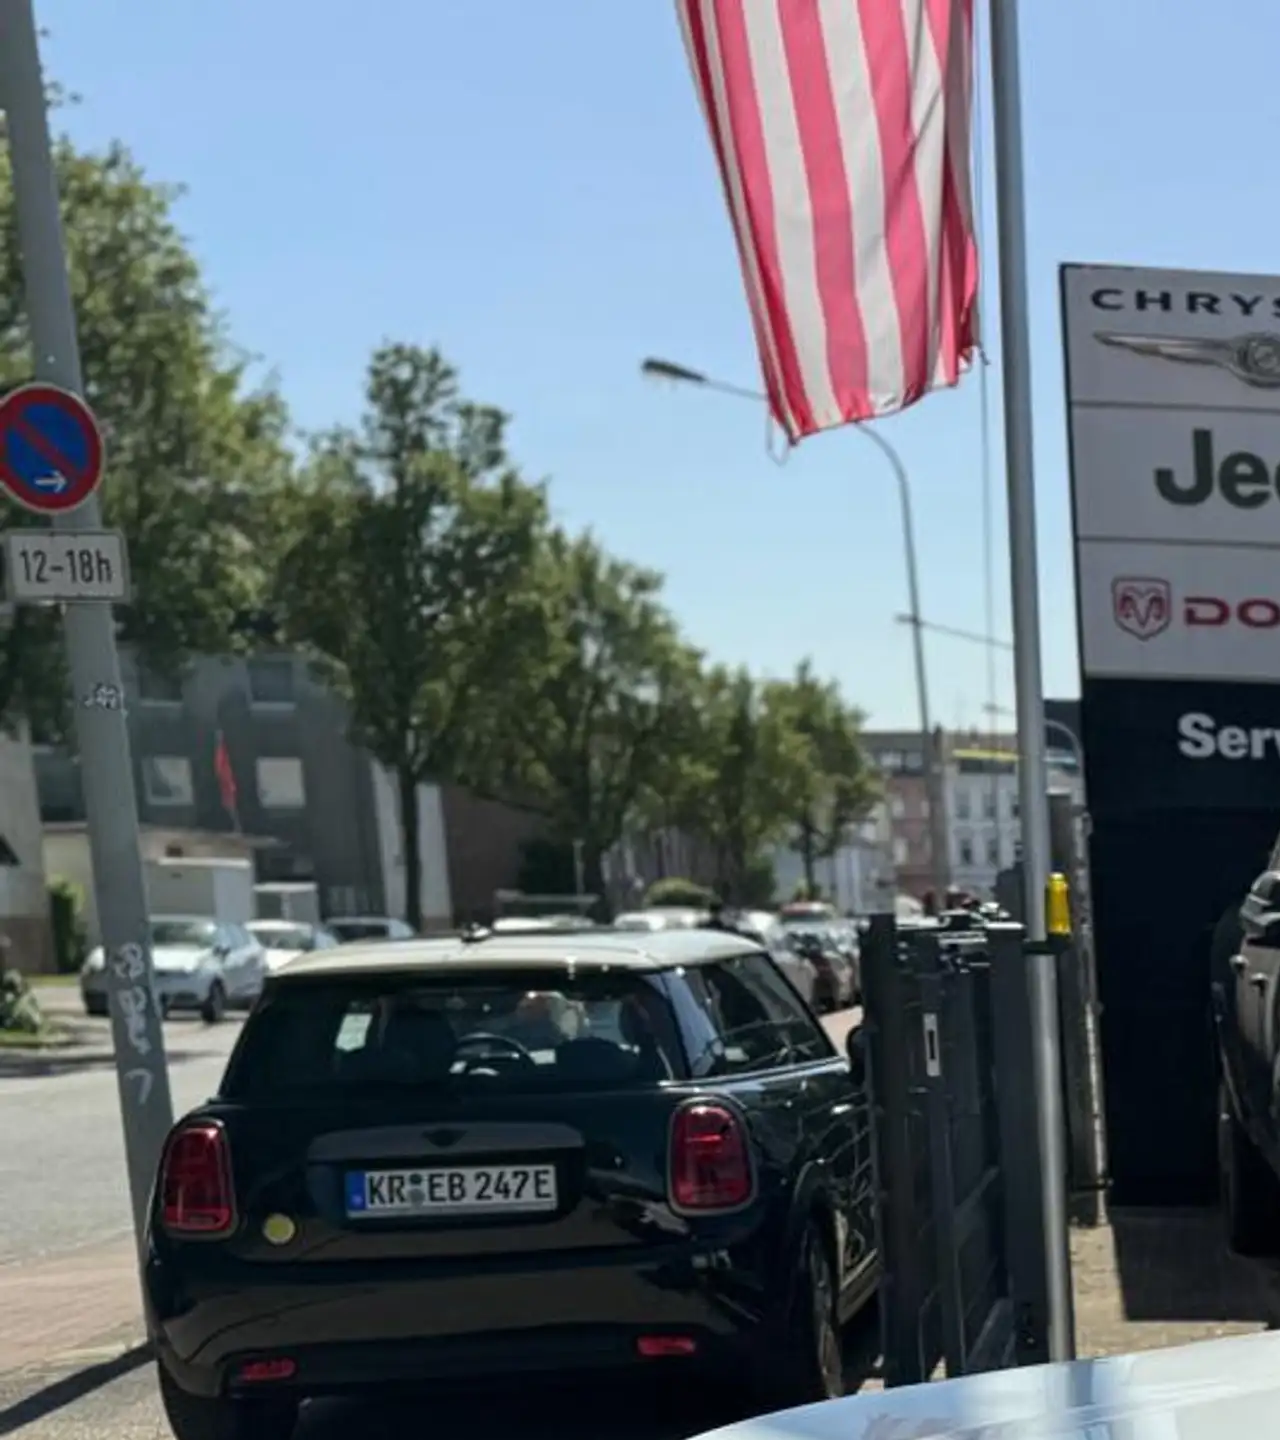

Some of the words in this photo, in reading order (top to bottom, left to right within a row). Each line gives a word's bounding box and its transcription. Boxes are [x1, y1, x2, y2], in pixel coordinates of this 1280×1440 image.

[19, 548, 112, 583] 12-18h
[369, 1175, 405, 1205] KR
[427, 1173, 466, 1202] EB
[475, 1169, 552, 1200] 247E
